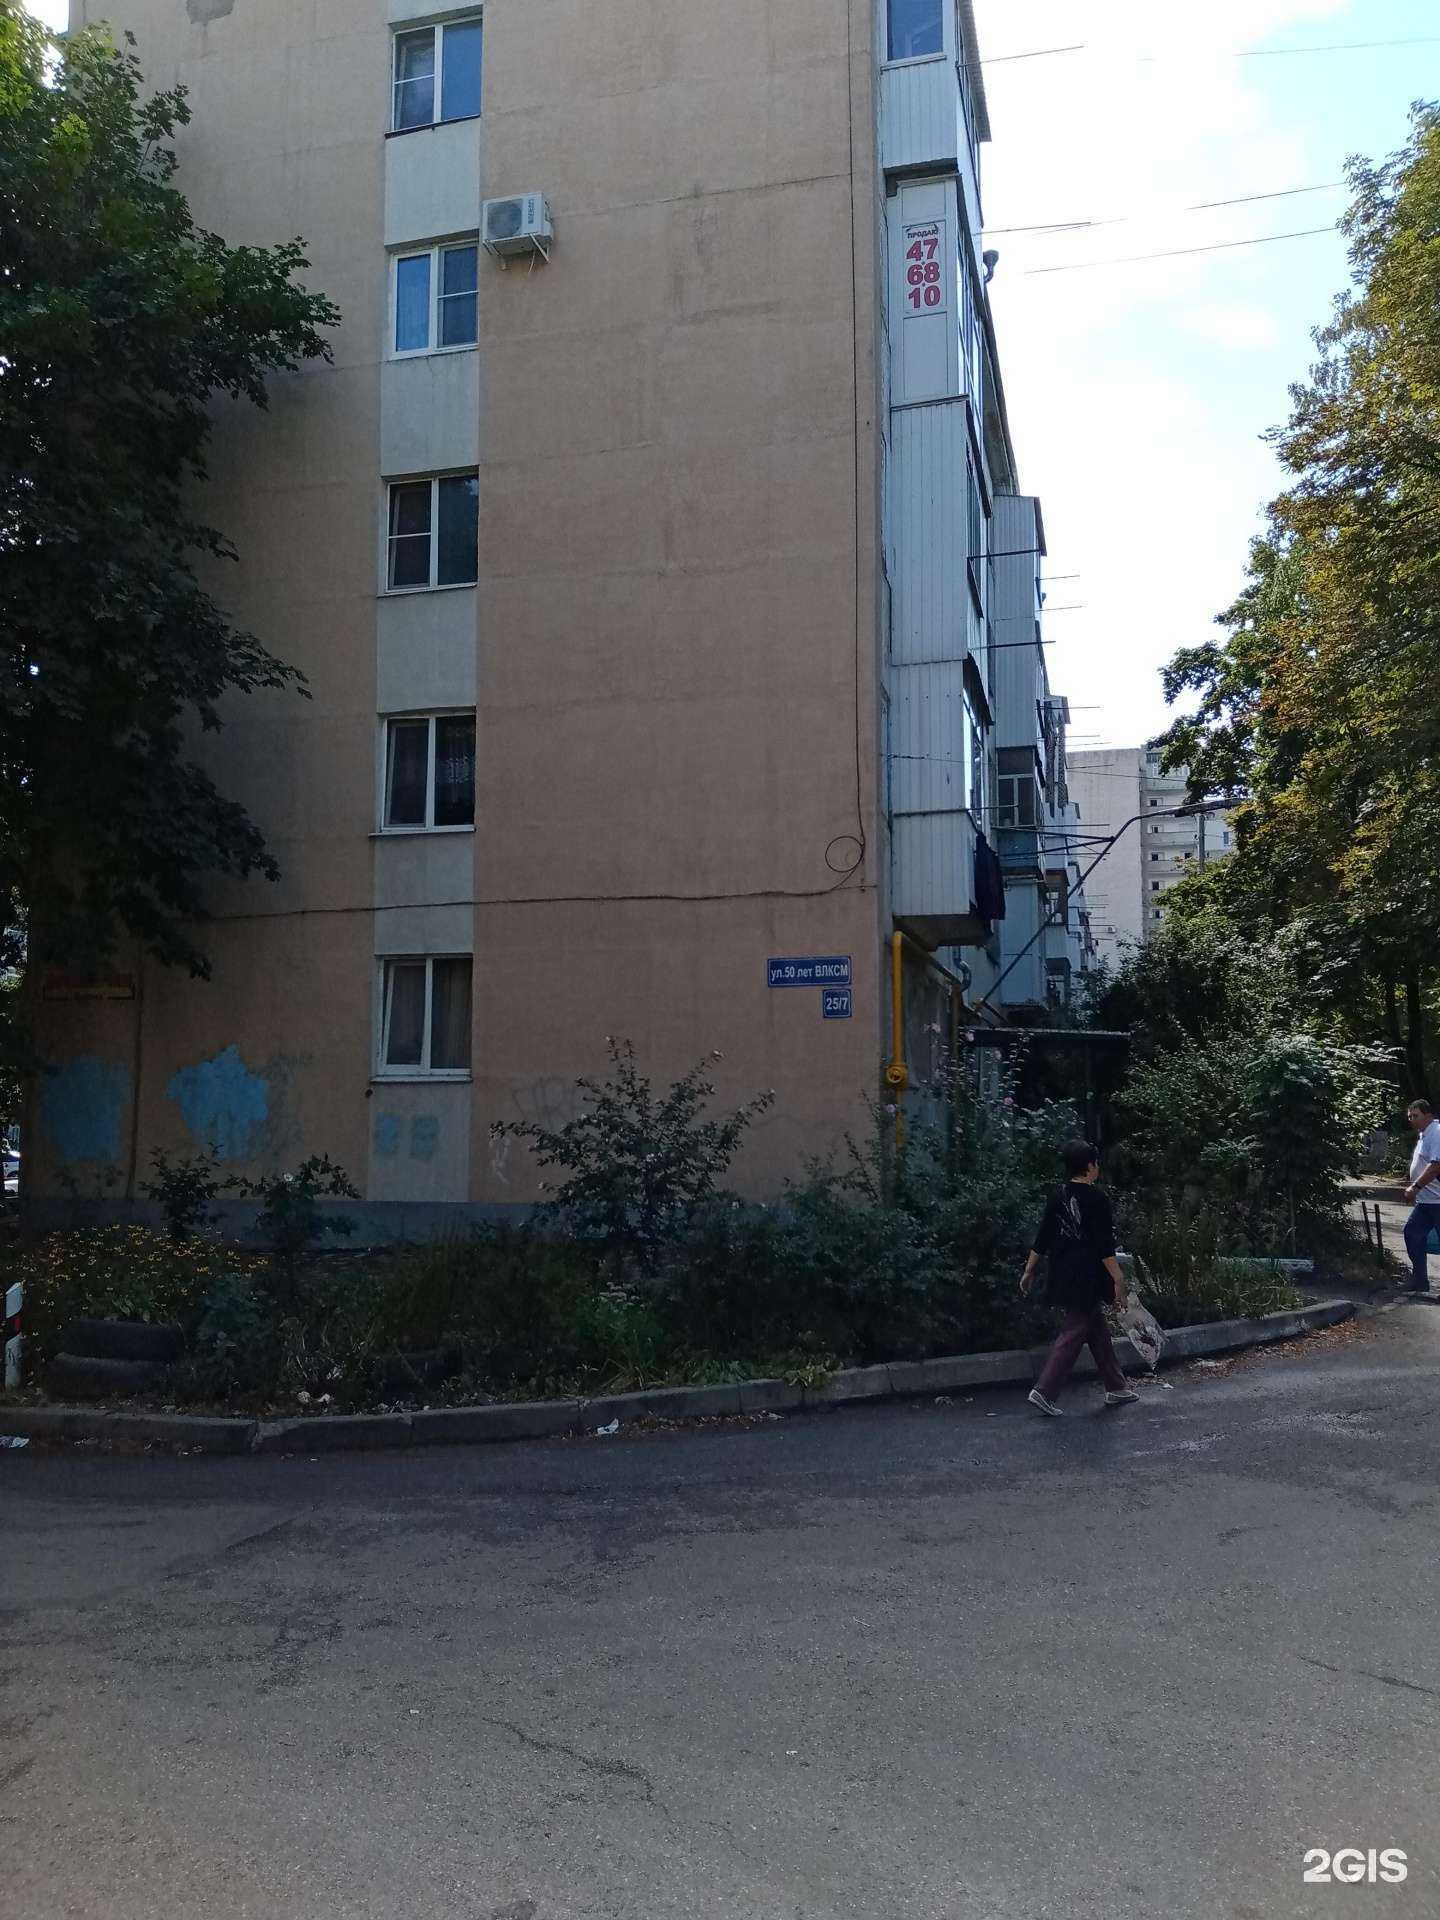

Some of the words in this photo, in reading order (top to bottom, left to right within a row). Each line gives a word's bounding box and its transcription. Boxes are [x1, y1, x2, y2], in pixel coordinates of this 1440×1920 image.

[907, 229, 938, 239] ПРОДАЮ
[906, 238, 938, 261] 47
[907, 262, 940, 285] 68
[908, 285, 940, 308] 10
[797, 968, 812, 978] лет
[815, 964, 848, 977] ВЛКСМ
[826, 997, 848, 1010] 25/7
